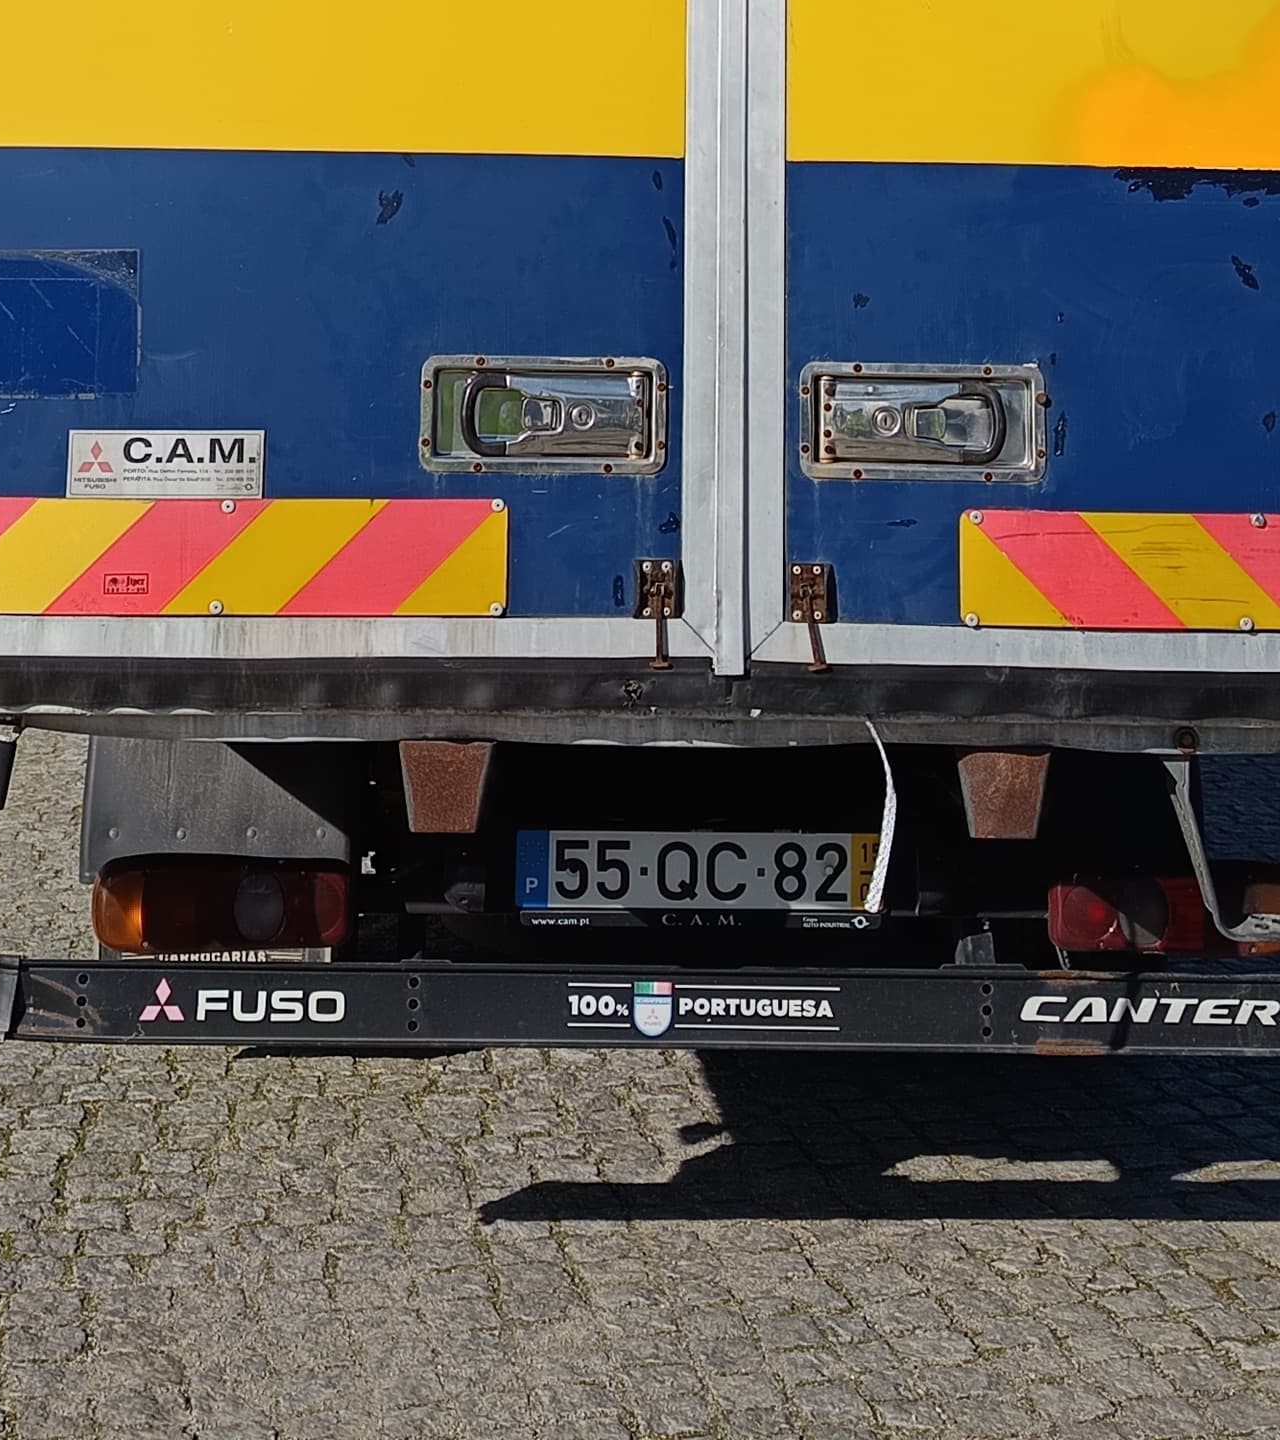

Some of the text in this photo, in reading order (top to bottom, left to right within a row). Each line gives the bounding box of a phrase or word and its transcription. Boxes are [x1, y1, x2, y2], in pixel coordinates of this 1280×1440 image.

[123, 437, 256, 464] C.A.M.
[525, 878, 538, 894] P
[531, 916, 590, 927] www.cam.pt
[195, 990, 346, 1022] FUSO
[568, 994, 834, 1018] 100% PORTUGUESA
